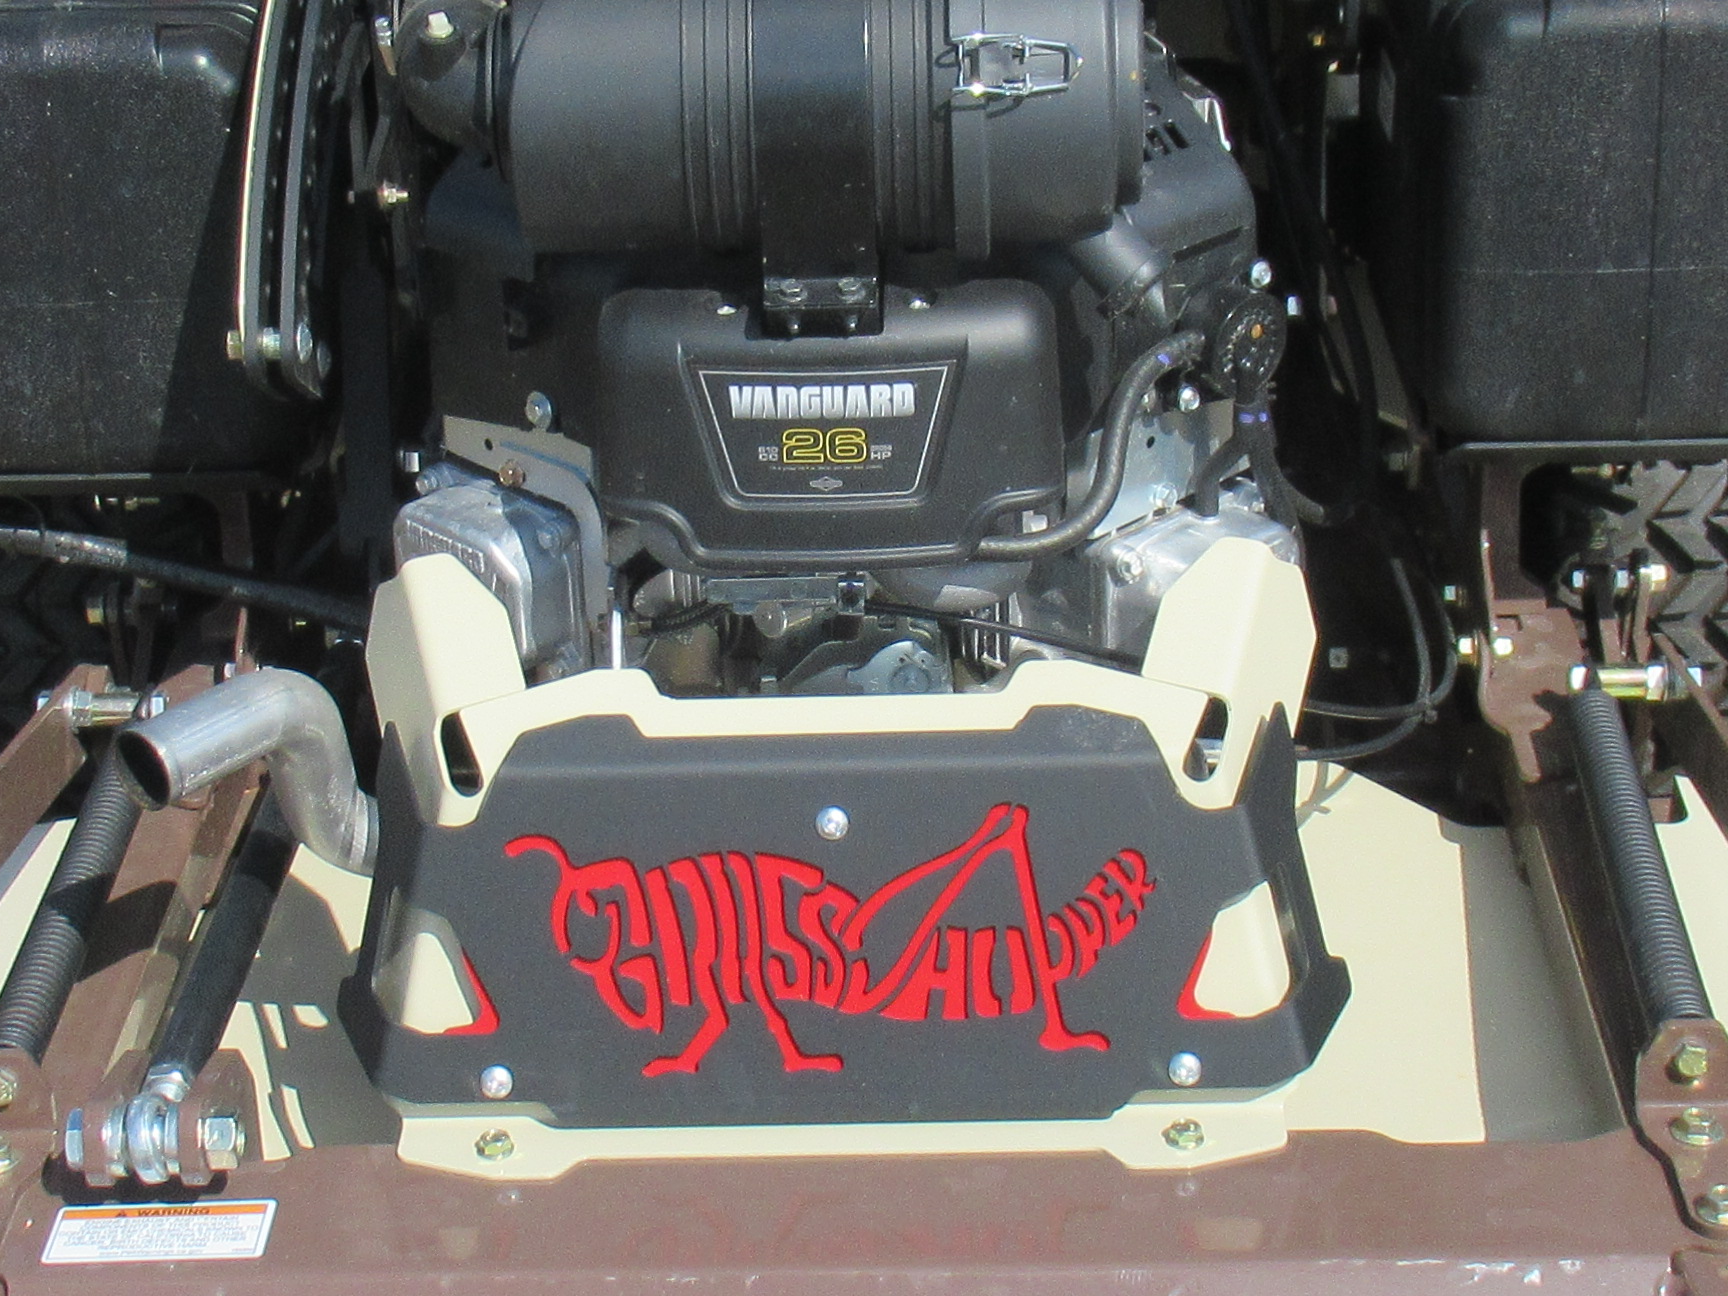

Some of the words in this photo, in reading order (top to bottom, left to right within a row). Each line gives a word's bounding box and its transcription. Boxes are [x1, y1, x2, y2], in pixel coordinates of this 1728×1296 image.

[728, 382, 916, 420] VANGUARD
[782, 427, 868, 464] 26
[870, 451, 892, 461] HP
[136, 1207, 211, 1218] WARNING
